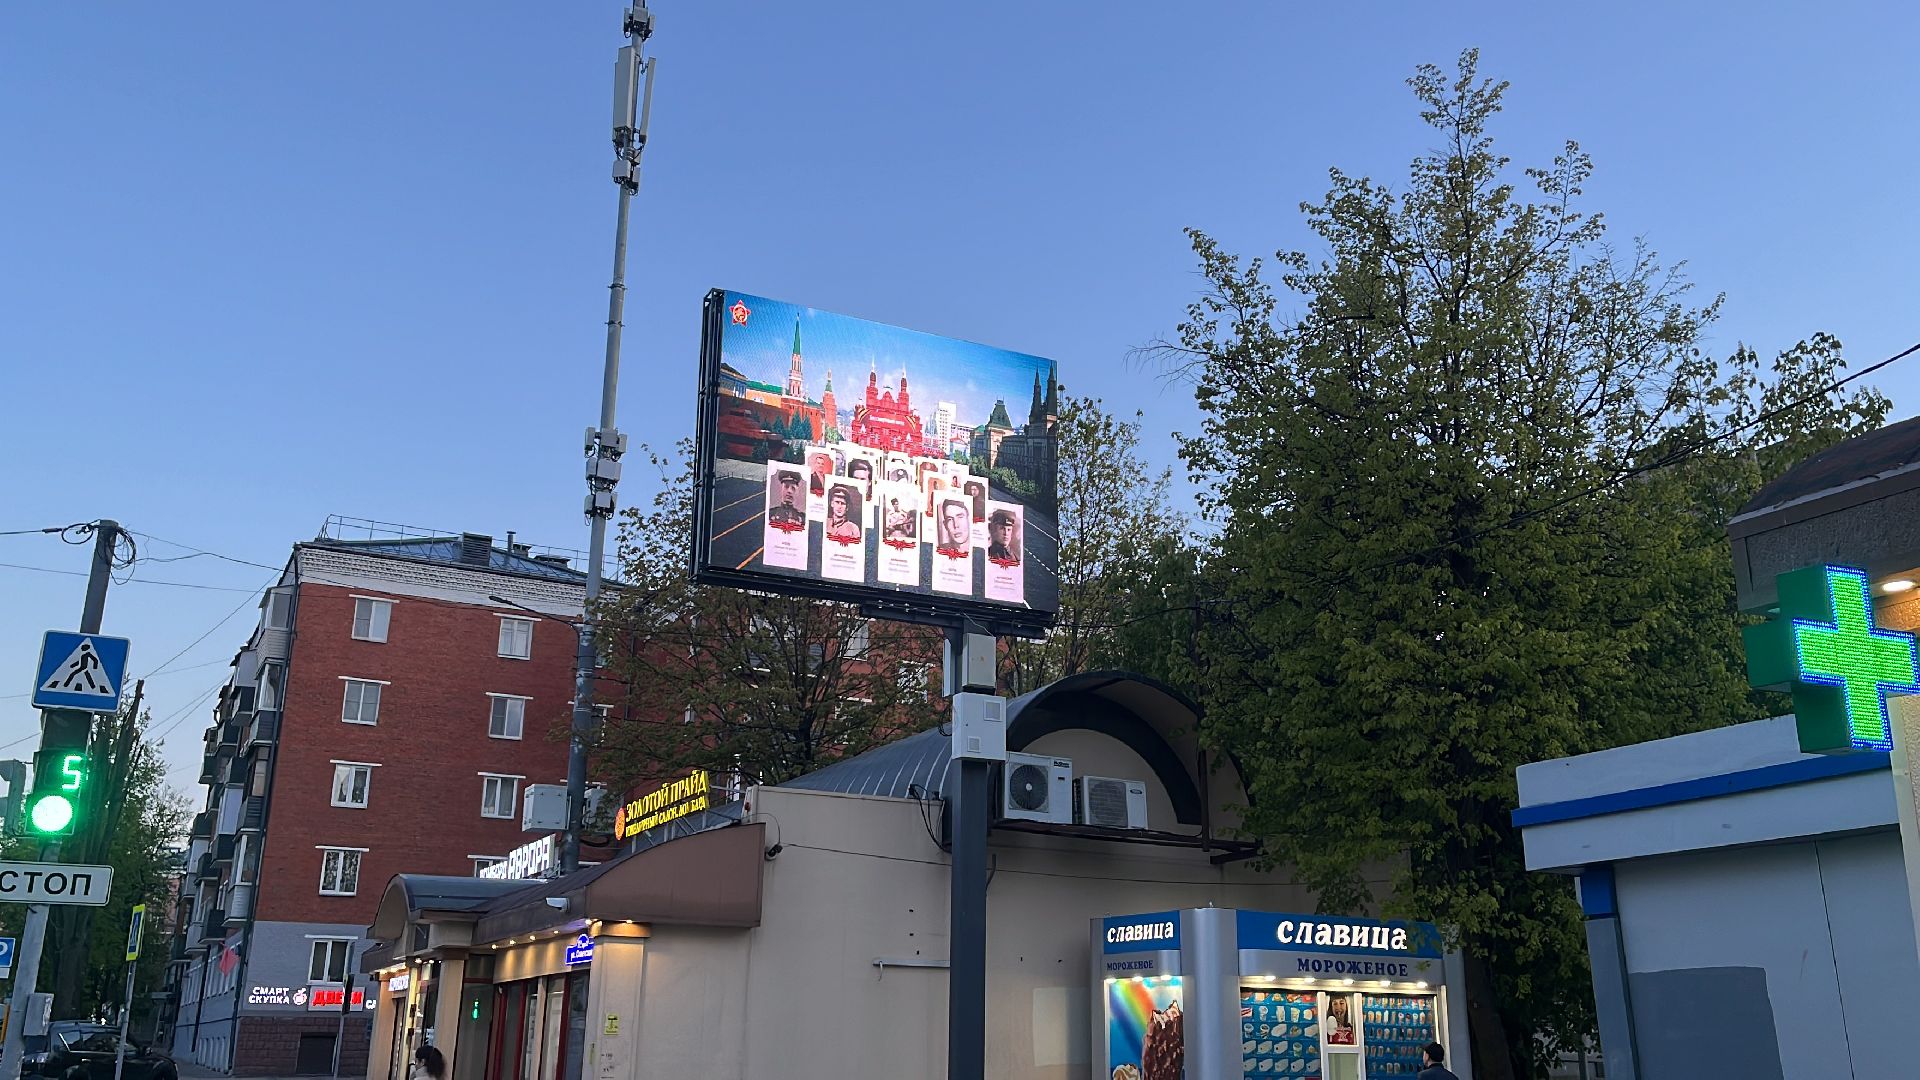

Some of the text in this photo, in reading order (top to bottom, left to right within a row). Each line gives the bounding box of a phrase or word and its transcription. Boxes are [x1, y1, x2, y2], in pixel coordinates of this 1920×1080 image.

[62, 756, 82, 790] 5
[626, 769, 707, 823] ЗОЛОТОЙ ПРАЙД
[508, 835, 551, 880] АВРОРА
[0, 870, 92, 896] СТОП
[1106, 959, 1154, 972] МОРОЖЕНОЕ
[1297, 957, 1409, 977] МОРОЖЕНОЕ
[248, 995, 290, 1005] СКУПКА
[252, 986, 290, 997] СМАРТ
[312, 990, 362, 1006] ДВЕИ
